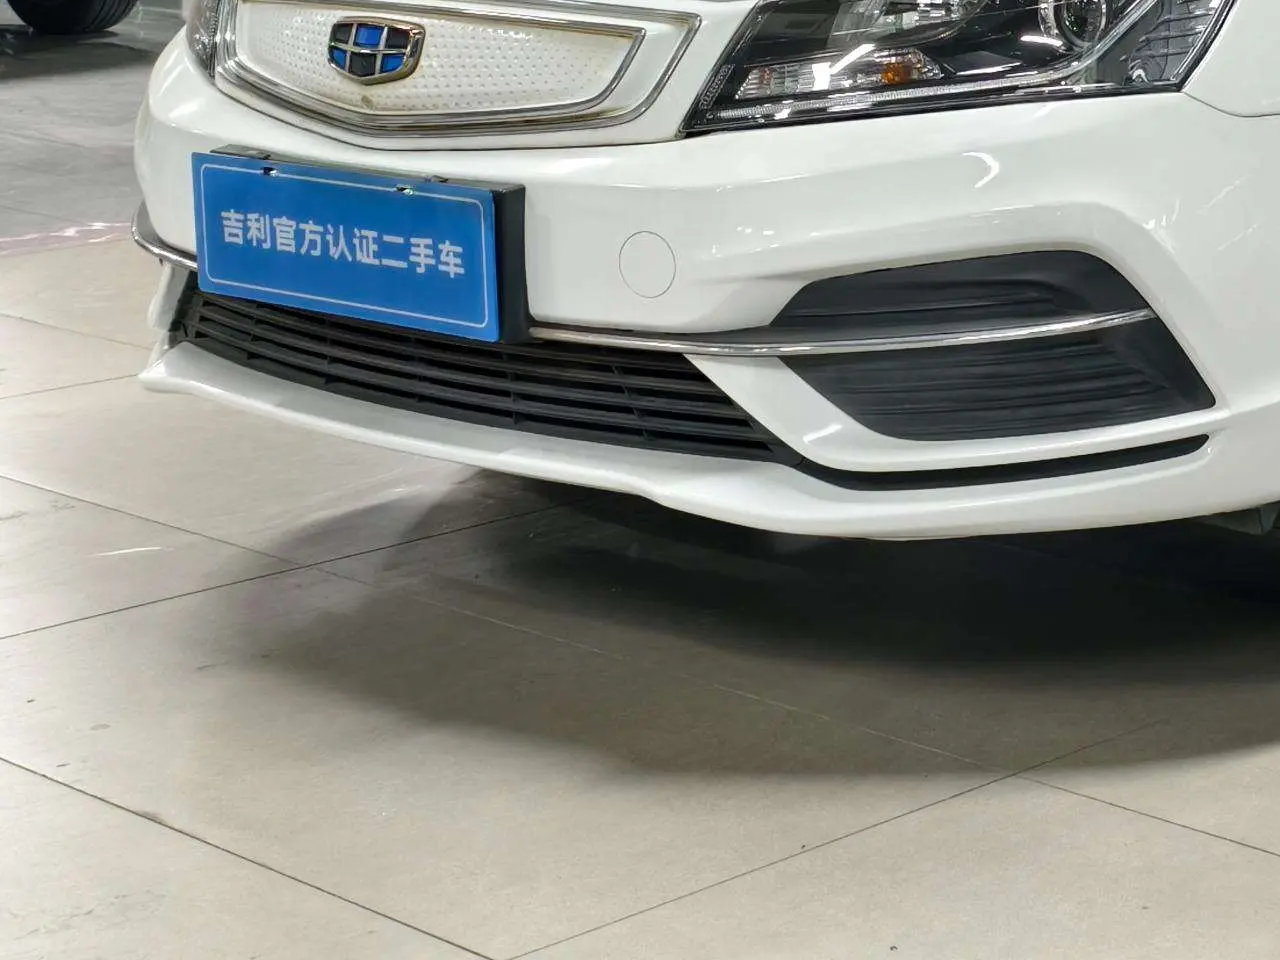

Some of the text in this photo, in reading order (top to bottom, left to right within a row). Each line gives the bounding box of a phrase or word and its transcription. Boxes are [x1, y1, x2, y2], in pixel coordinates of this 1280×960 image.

[220, 208, 466, 279] 吉利官方认证二手车
